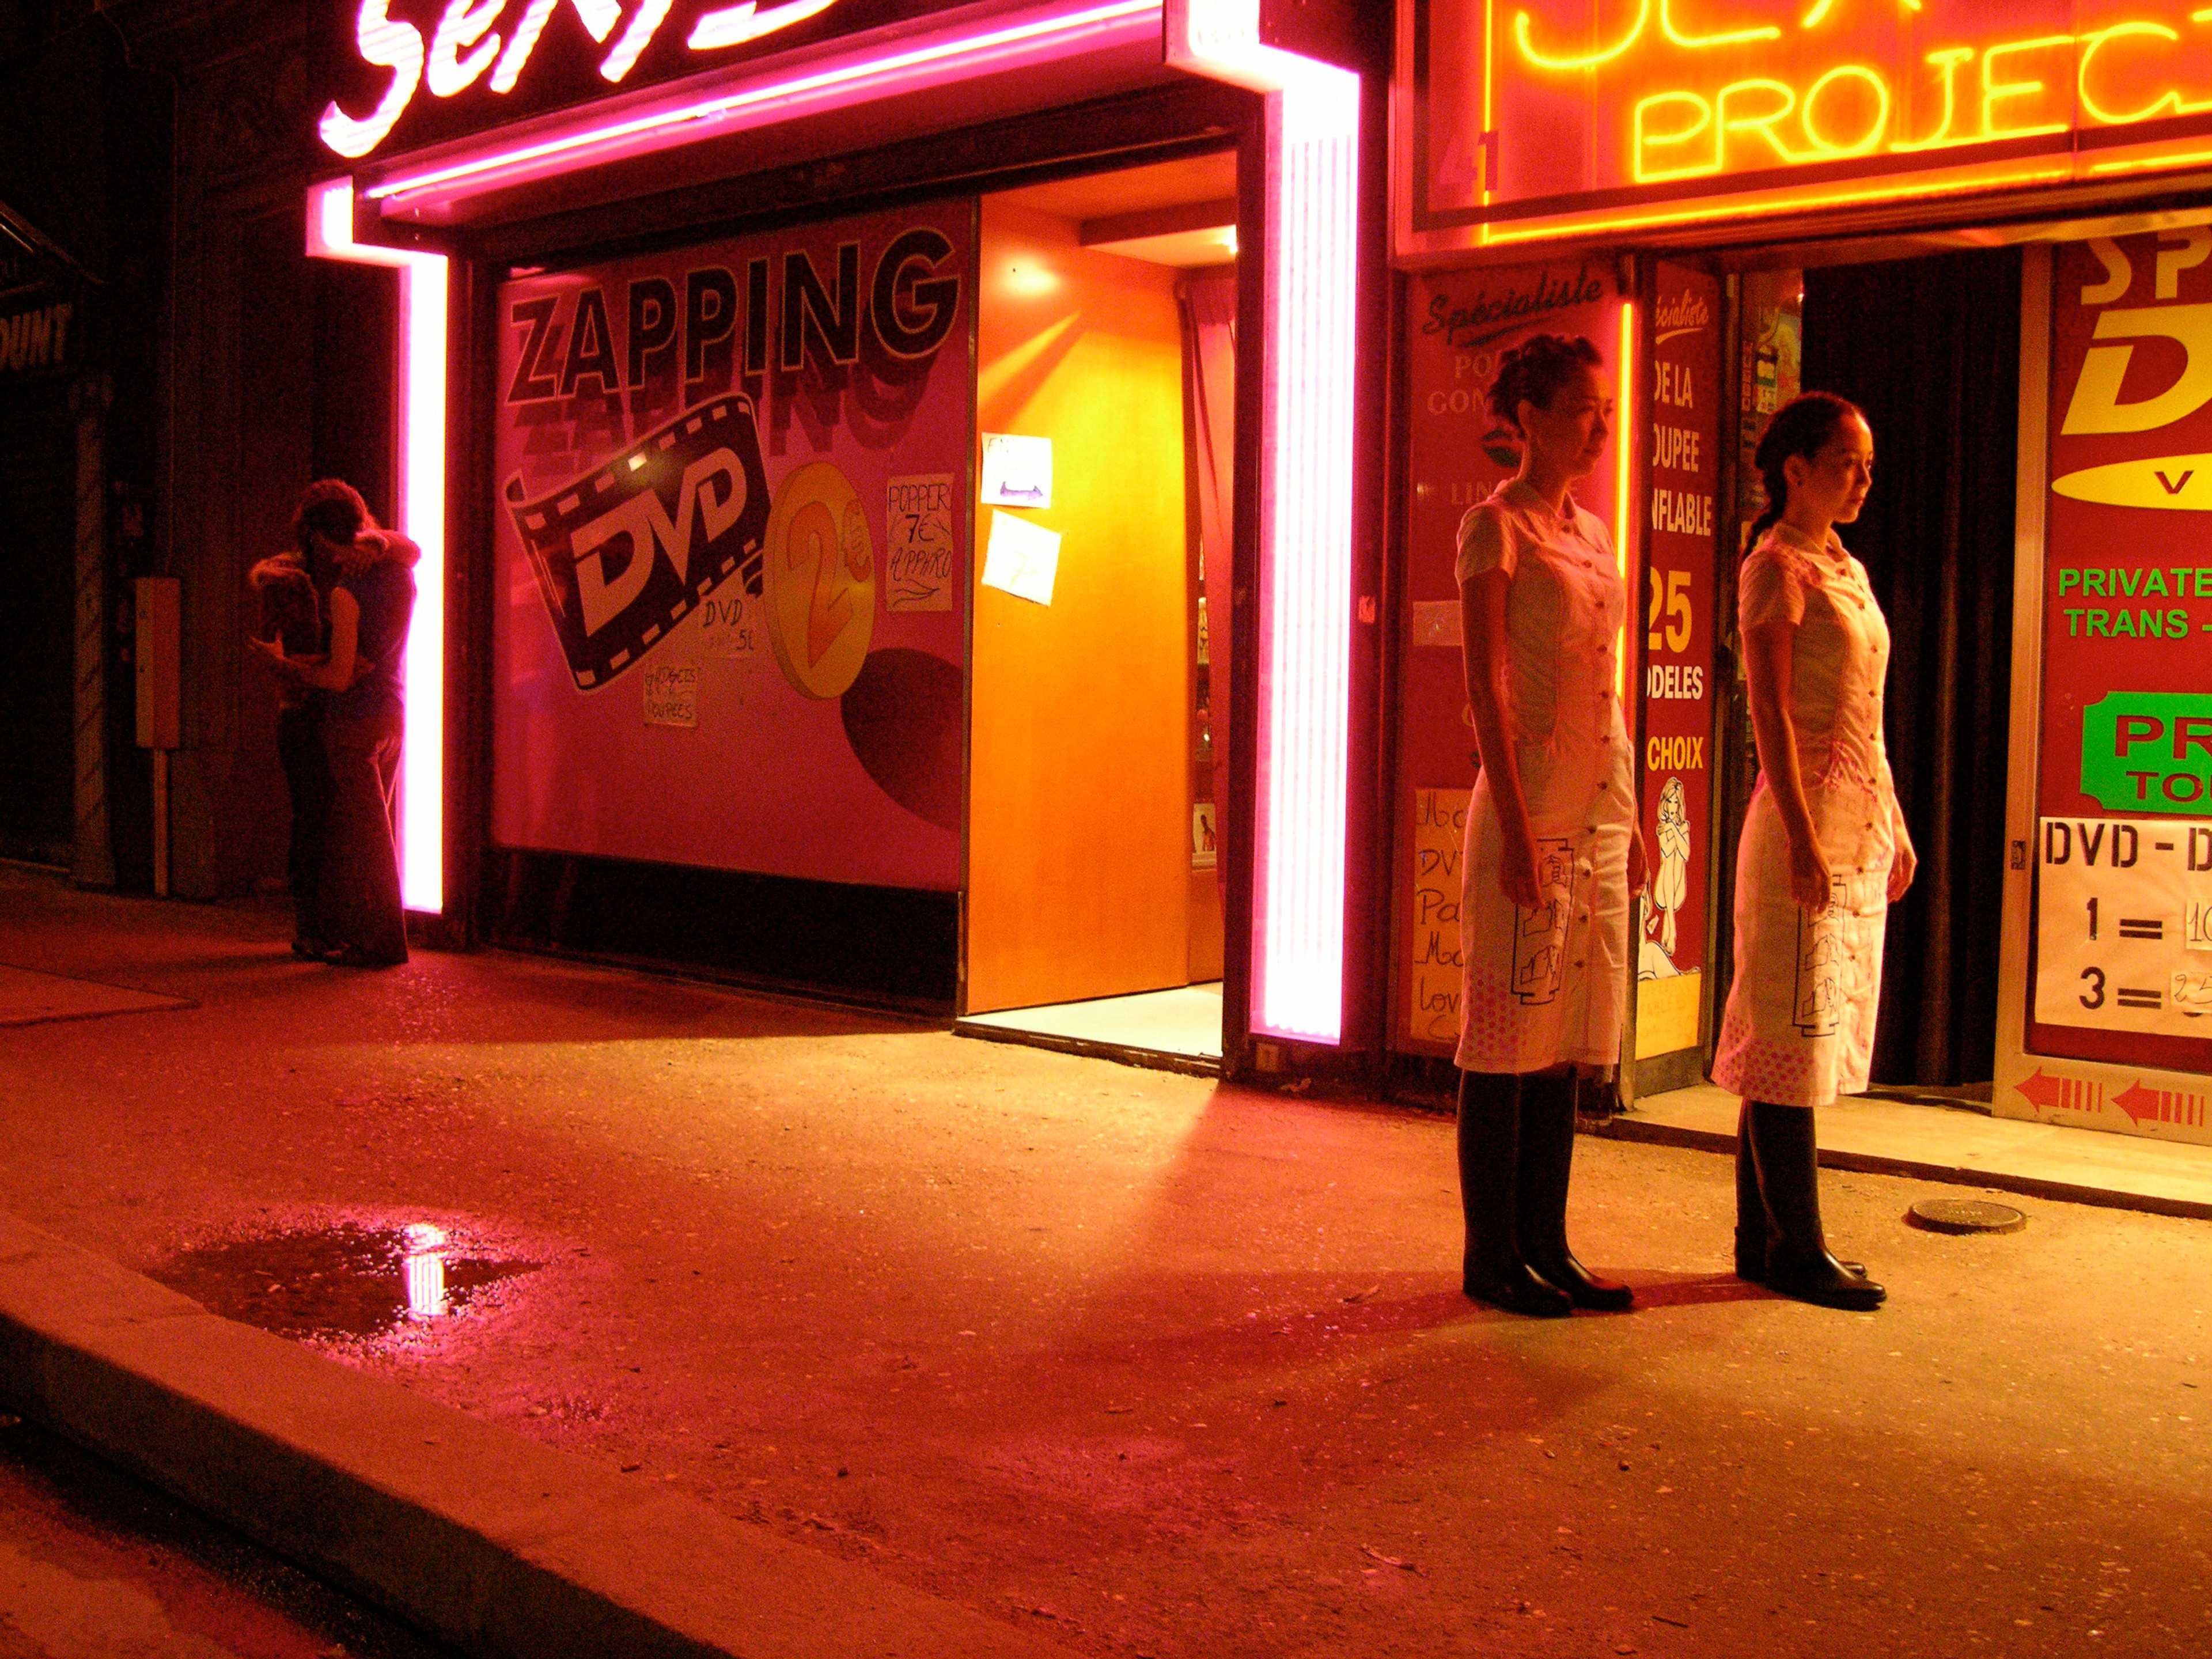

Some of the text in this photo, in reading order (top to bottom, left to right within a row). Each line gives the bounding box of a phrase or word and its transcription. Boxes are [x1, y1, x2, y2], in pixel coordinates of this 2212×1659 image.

[1634, 9, 2212, 182] PROJEC
[505, 228, 961, 407] ZAPPING
[1422, 268, 1603, 344] Spécialiste
[1675, 364, 1693, 409] LA
[889, 483, 951, 512] POPPER
[570, 447, 748, 638] DVD
[2059, 567, 2212, 597] PRIVATE
[703, 599, 743, 628] DVD
[1649, 566, 1692, 653] 25
[2064, 608, 2188, 639] TRANS
[1647, 736, 1703, 771] CHOIX
[2126, 771, 2212, 803] TO
[1419, 849, 1463, 876] DV
[2046, 822, 2139, 868] DVD
[1417, 888, 1460, 925] Pa
[2086, 897, 2099, 941] 1
[1421, 976, 1460, 1013] Lov
[2079, 966, 2106, 1010] 3
